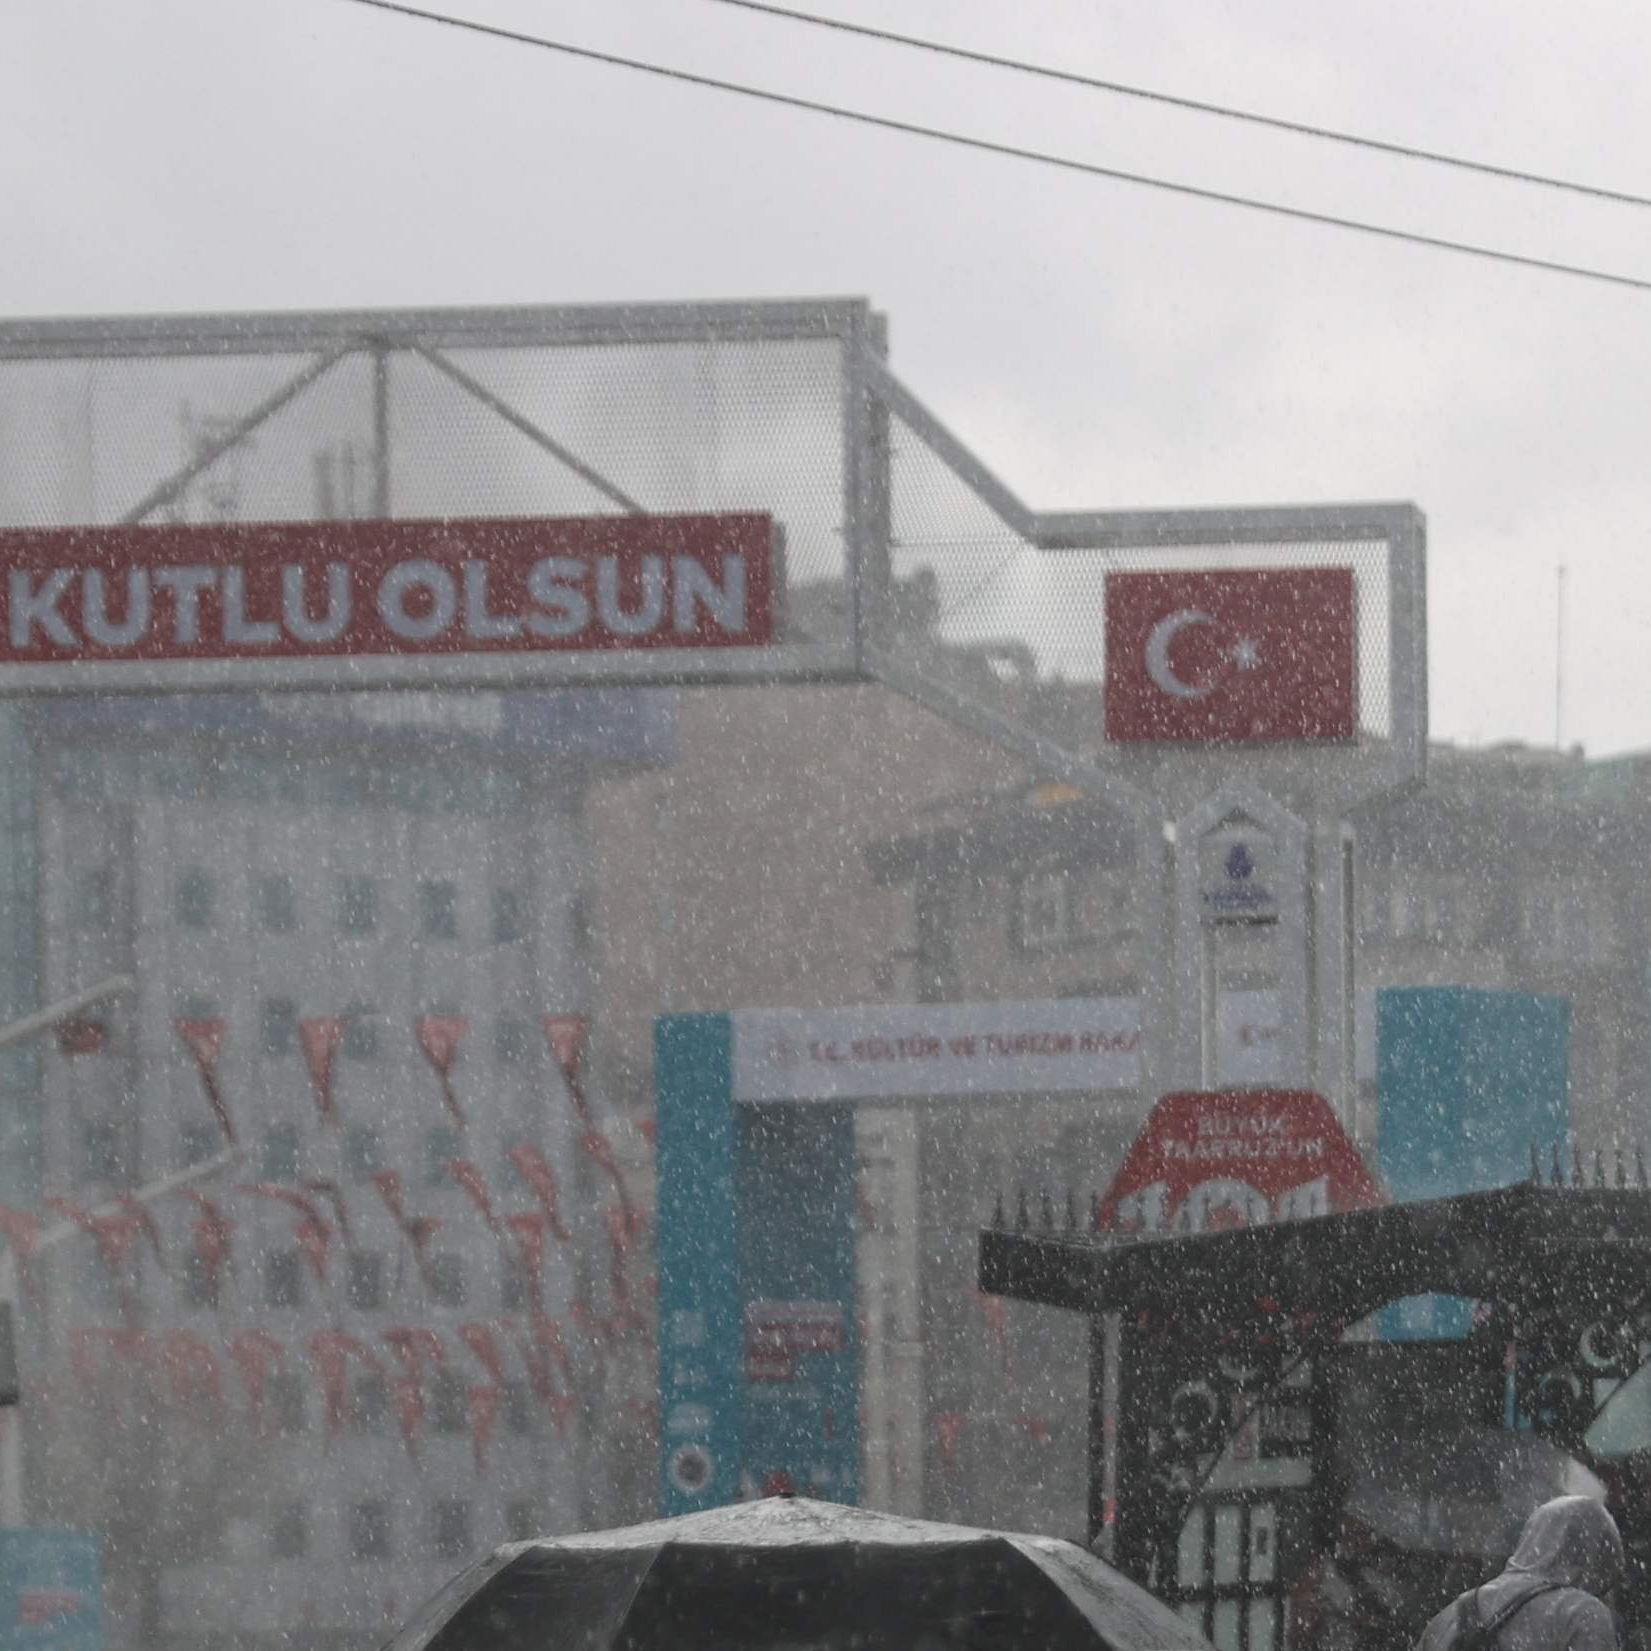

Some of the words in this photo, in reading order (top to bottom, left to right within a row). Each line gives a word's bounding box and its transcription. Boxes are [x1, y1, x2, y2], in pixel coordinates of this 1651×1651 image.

[9, 564, 348, 648] KUTLU
[378, 554, 747, 641] OLSUN
[1199, 1107, 1285, 1134] BÜYÜK
